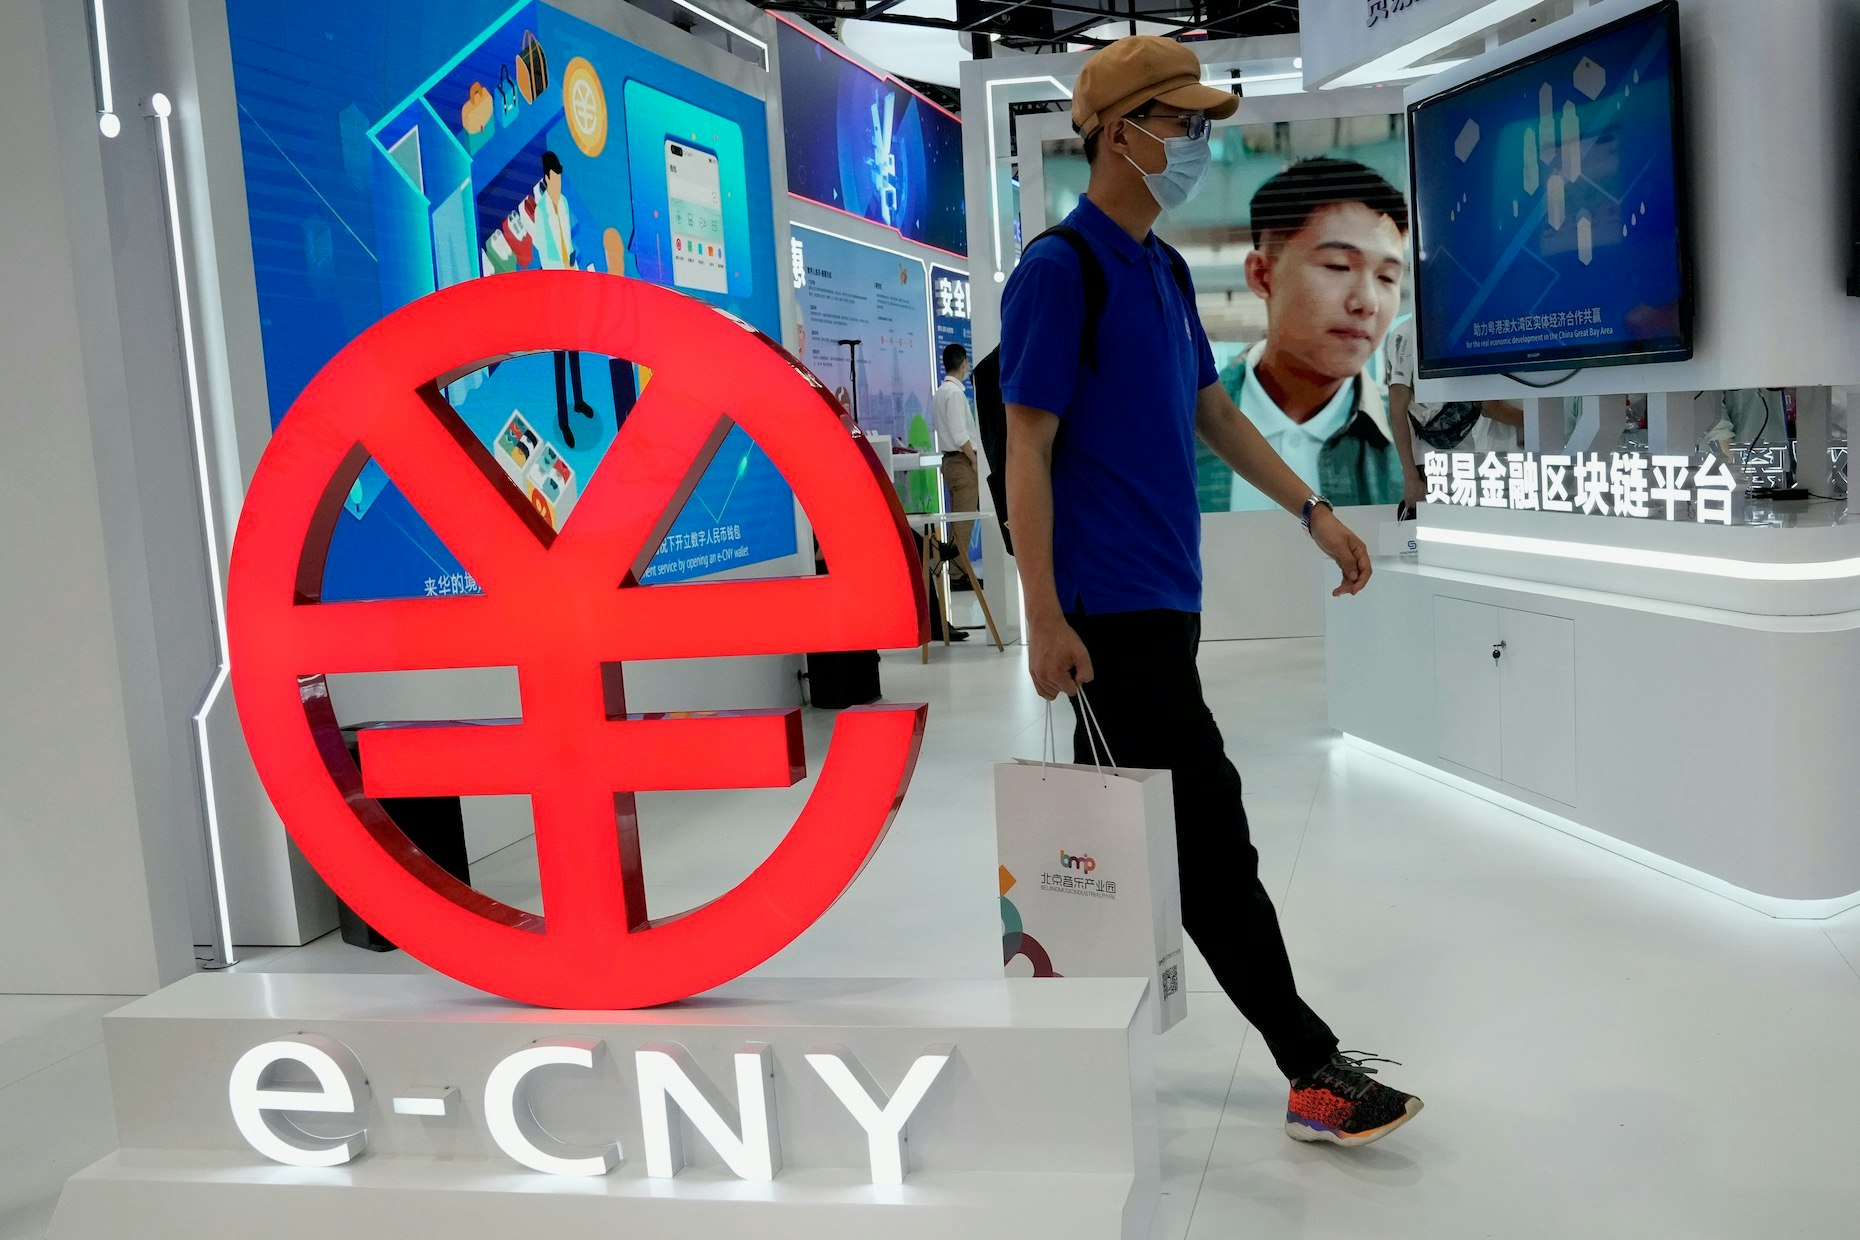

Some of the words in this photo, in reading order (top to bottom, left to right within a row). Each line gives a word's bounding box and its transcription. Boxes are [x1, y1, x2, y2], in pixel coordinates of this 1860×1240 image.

[939, 277, 971, 319] 安全
[1473, 308, 1601, 336] 助力粤港澳大湾区实体经济合作共赢
[1481, 339, 1490, 347] real
[1490, 338, 1511, 346] economic
[1512, 335, 1543, 344] development
[1550, 332, 1558, 340] the
[1559, 331, 1574, 339] China
[1574, 329, 1589, 337] Great
[1590, 328, 1600, 337] Bay
[1601, 327, 1613, 335] Area
[1425, 451, 1737, 525] 贸易金融区块链平台
[656, 525, 741, 555] 况下开立数字人民币钱包
[658, 561, 678, 575] service
[678, 557, 686, 573] by
[687, 553, 709, 570] opening
[709, 553, 717, 562] an
[718, 547, 734, 562] e-CNY
[734, 545, 749, 558] wallet
[424, 571, 482, 596] 来华的境
[1041, 872, 1116, 893] 北京音乐产业园
[229, 1041, 949, 1185] e-CNY
